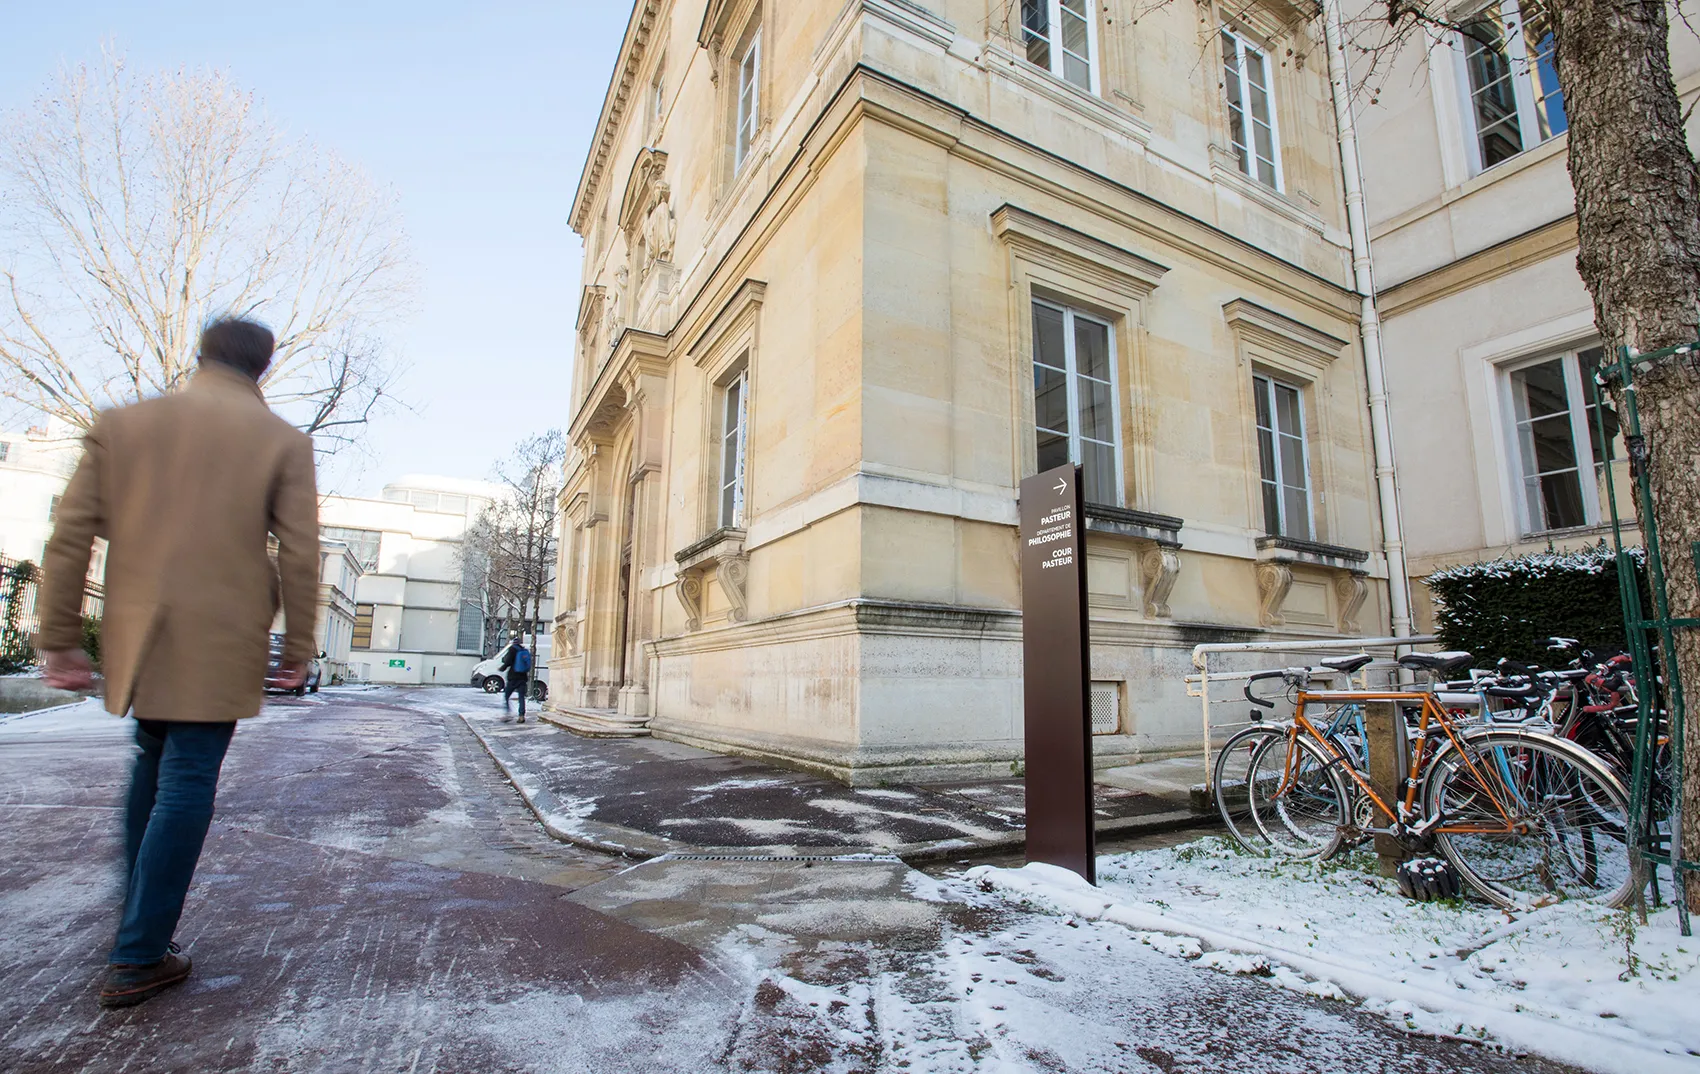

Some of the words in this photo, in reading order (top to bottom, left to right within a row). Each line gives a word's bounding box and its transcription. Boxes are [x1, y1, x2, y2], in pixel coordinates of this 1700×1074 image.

[1051, 505, 1071, 514] PAVILLON
[1041, 511, 1071, 525] PASTEUR
[1028, 529, 1072, 546] PHILOSOPHIE
[1052, 547, 1072, 558] COUR
[1042, 556, 1073, 569] PASTEUR
